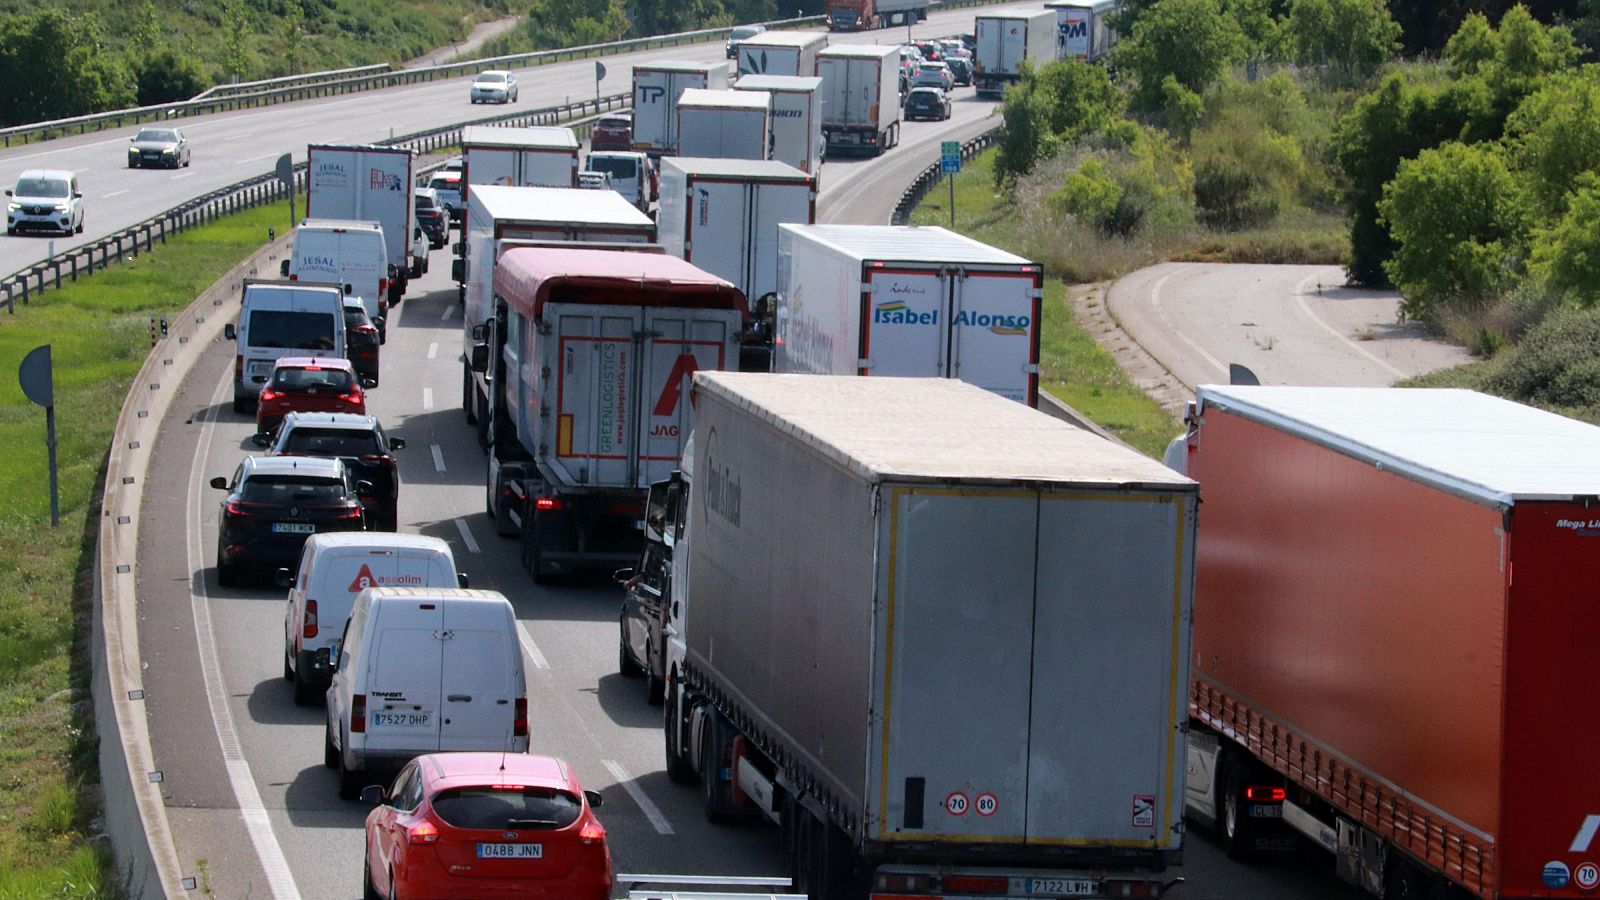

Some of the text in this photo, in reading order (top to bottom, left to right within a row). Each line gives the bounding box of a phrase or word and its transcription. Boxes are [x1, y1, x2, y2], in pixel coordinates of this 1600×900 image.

[638, 86, 665, 103] TP
[304, 257, 334, 267] JESAL
[875, 308, 1030, 328] Isabel Alonso
[601, 343, 616, 453] GREENLOGISTICS
[650, 425, 679, 437] JAG
[277, 523, 297, 532] 7401
[1556, 519, 1600, 530] Mega Li
[378, 574, 422, 584] assolim
[381, 714, 429, 725] 7527 DHP
[952, 799, 965, 809] 70
[980, 799, 993, 810] 80
[485, 845, 540, 856] 0488 JNN
[1582, 868, 1595, 879] 70
[1034, 881, 1088, 893] 7122 LWH
